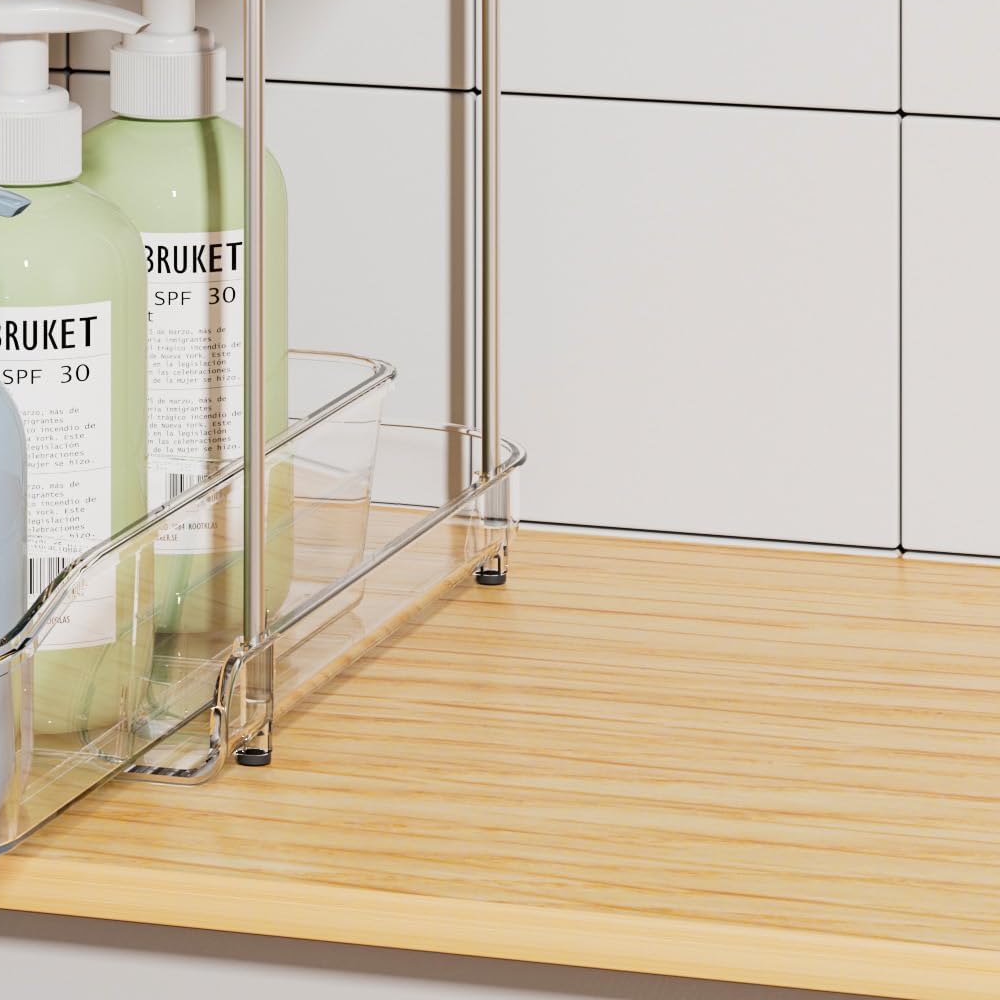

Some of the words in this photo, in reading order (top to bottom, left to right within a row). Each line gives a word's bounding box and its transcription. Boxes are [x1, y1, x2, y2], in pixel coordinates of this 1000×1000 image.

[154, 291, 192, 306] SPF
[208, 286, 236, 305] 30
[2, 369, 43, 385] SPF
[60, 363, 90, 384] 30
